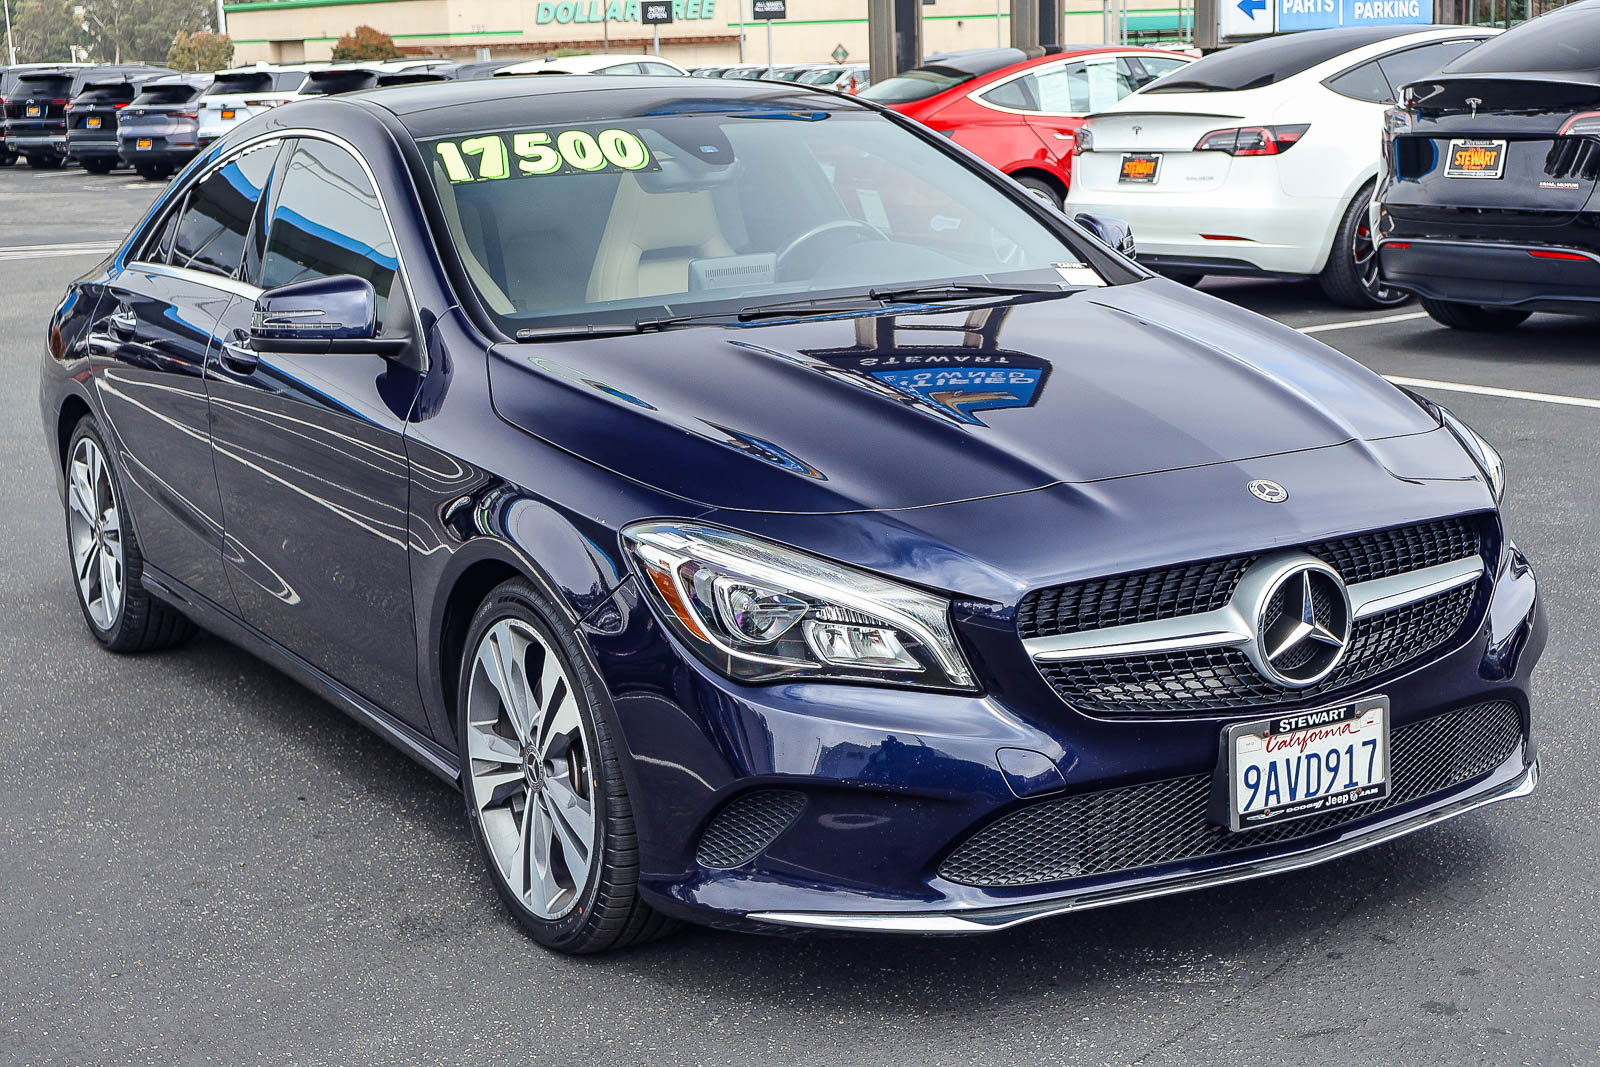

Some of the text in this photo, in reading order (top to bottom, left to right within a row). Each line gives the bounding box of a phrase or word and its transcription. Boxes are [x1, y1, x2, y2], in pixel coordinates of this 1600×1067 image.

[536, 0, 716, 24] DOLLAR REE
[647, 5, 667, 13] NOW
[1282, 0, 1336, 14] PARTS
[1354, 1, 1420, 19] PARKING
[646, 11, 668, 19] OPEN
[1455, 151, 1498, 166] STEWART
[1124, 161, 1156, 174] STEWART
[1279, 707, 1347, 733] STEWART
[1266, 722, 1361, 754] California
[1243, 738, 1377, 812] 9AVD917
[1325, 793, 1349, 806] Jeep
